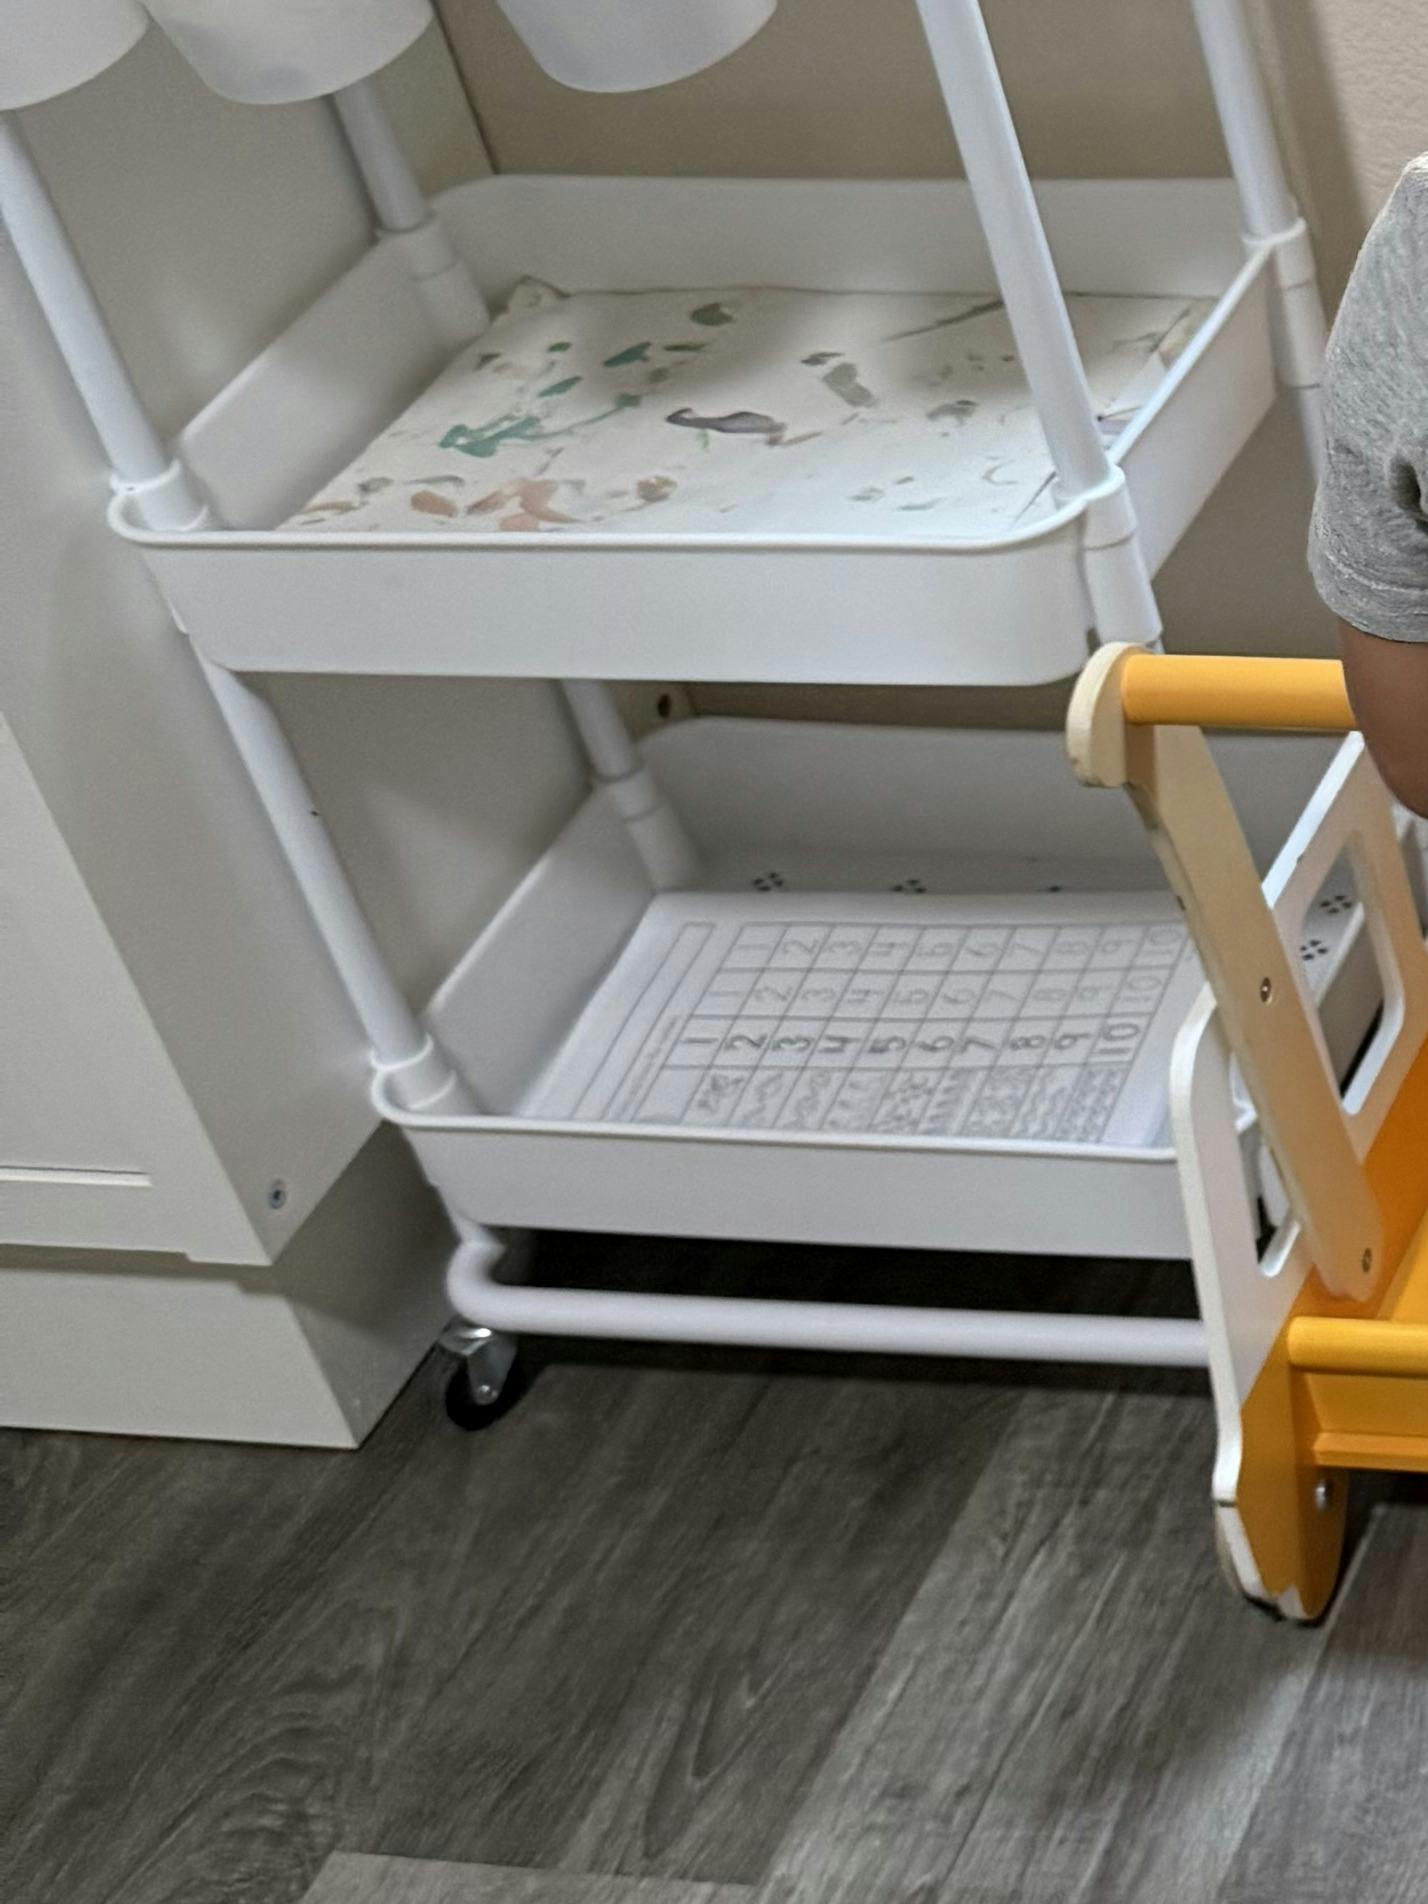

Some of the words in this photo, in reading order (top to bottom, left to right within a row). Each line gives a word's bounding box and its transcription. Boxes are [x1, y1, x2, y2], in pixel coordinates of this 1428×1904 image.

[723, 1034, 768, 1052] 2
[771, 1036, 814, 1053] 3
[817, 1035, 862, 1053] 4
[867, 1036, 908, 1054] 5
[917, 1035, 955, 1054] 6
[958, 1037, 997, 1054] 7
[1009, 1035, 1047, 1051] 8
[1053, 1032, 1095, 1050] 9
[1097, 1022, 1141, 1055] 10
